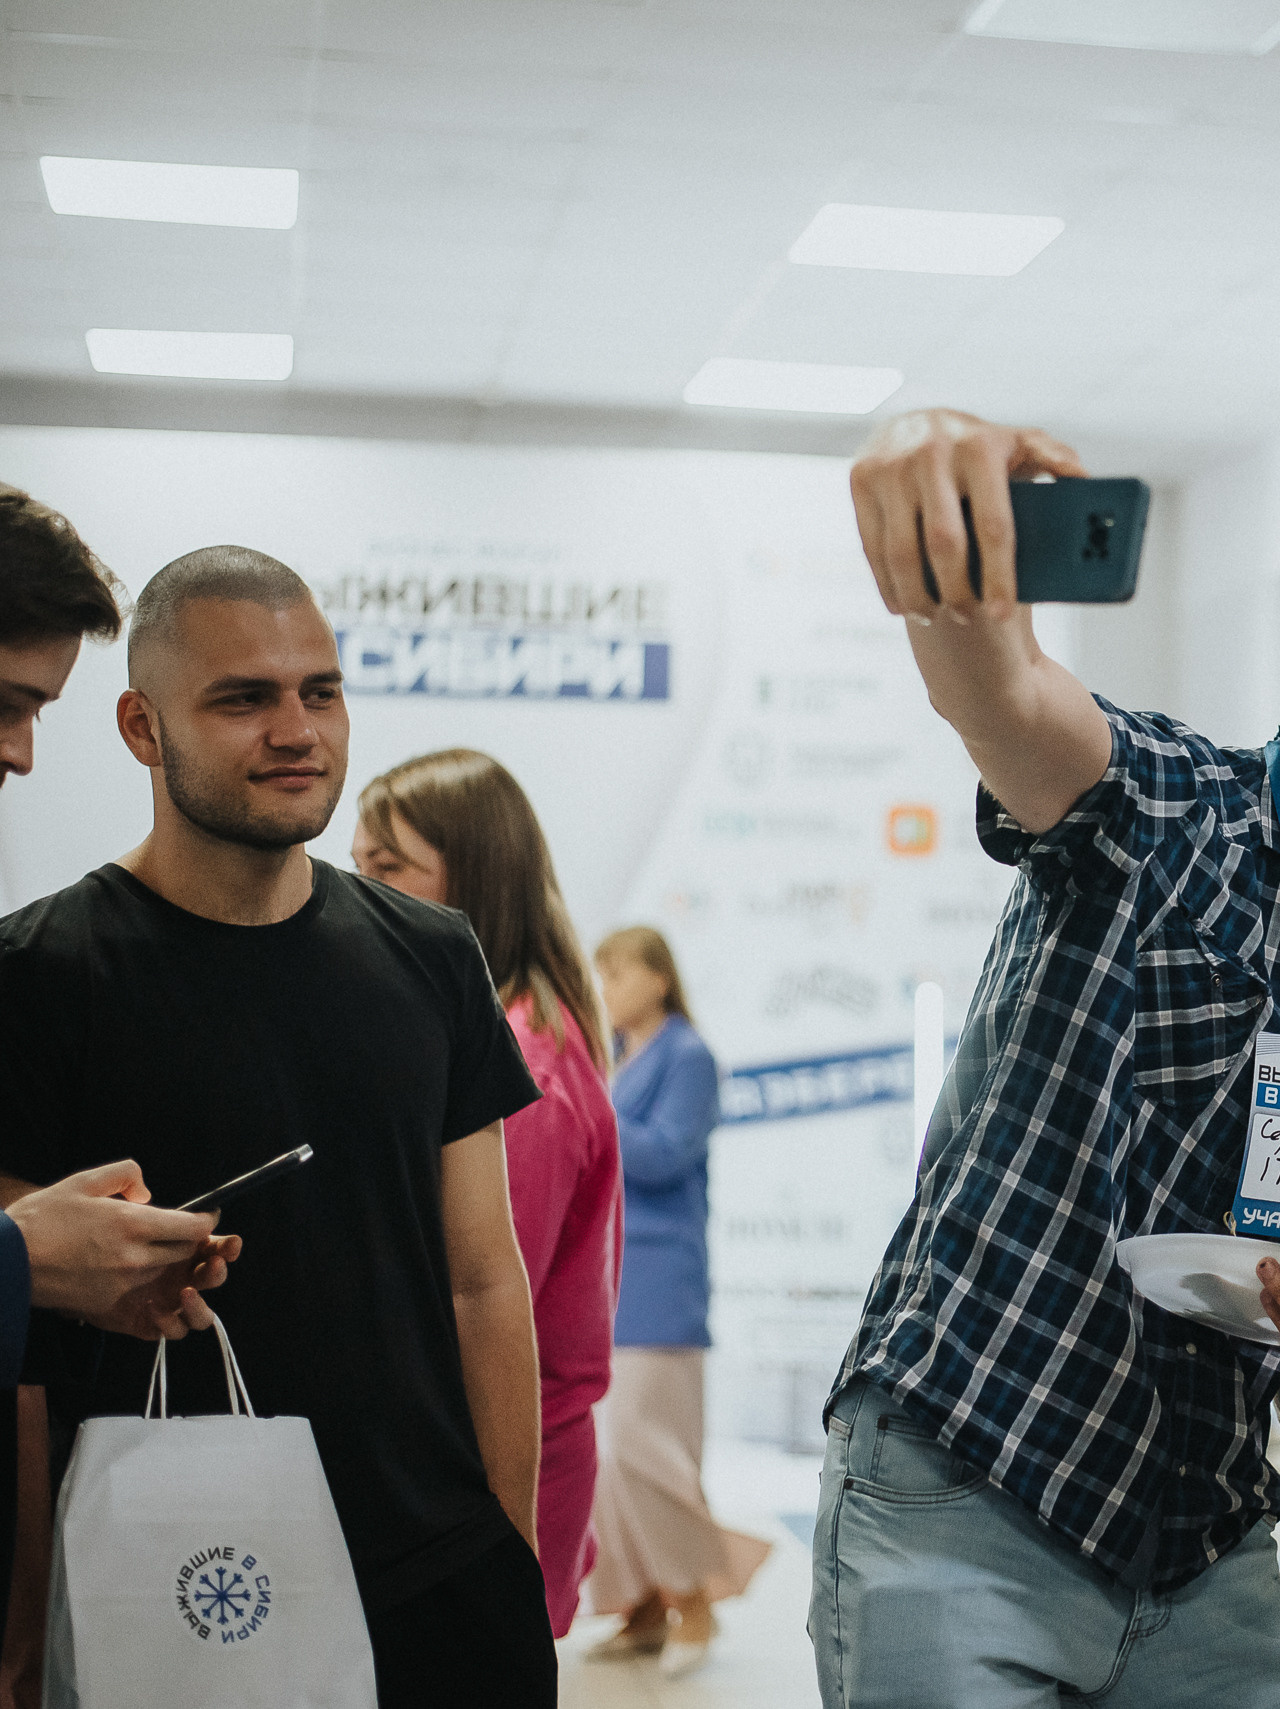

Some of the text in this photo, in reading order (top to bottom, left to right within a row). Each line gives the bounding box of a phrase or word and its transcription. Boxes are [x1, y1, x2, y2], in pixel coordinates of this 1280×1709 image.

[1265, 1087, 1279, 1105] В
[176, 1547, 271, 1644] ВЫЖИВШИЕ В СИБИРИ
